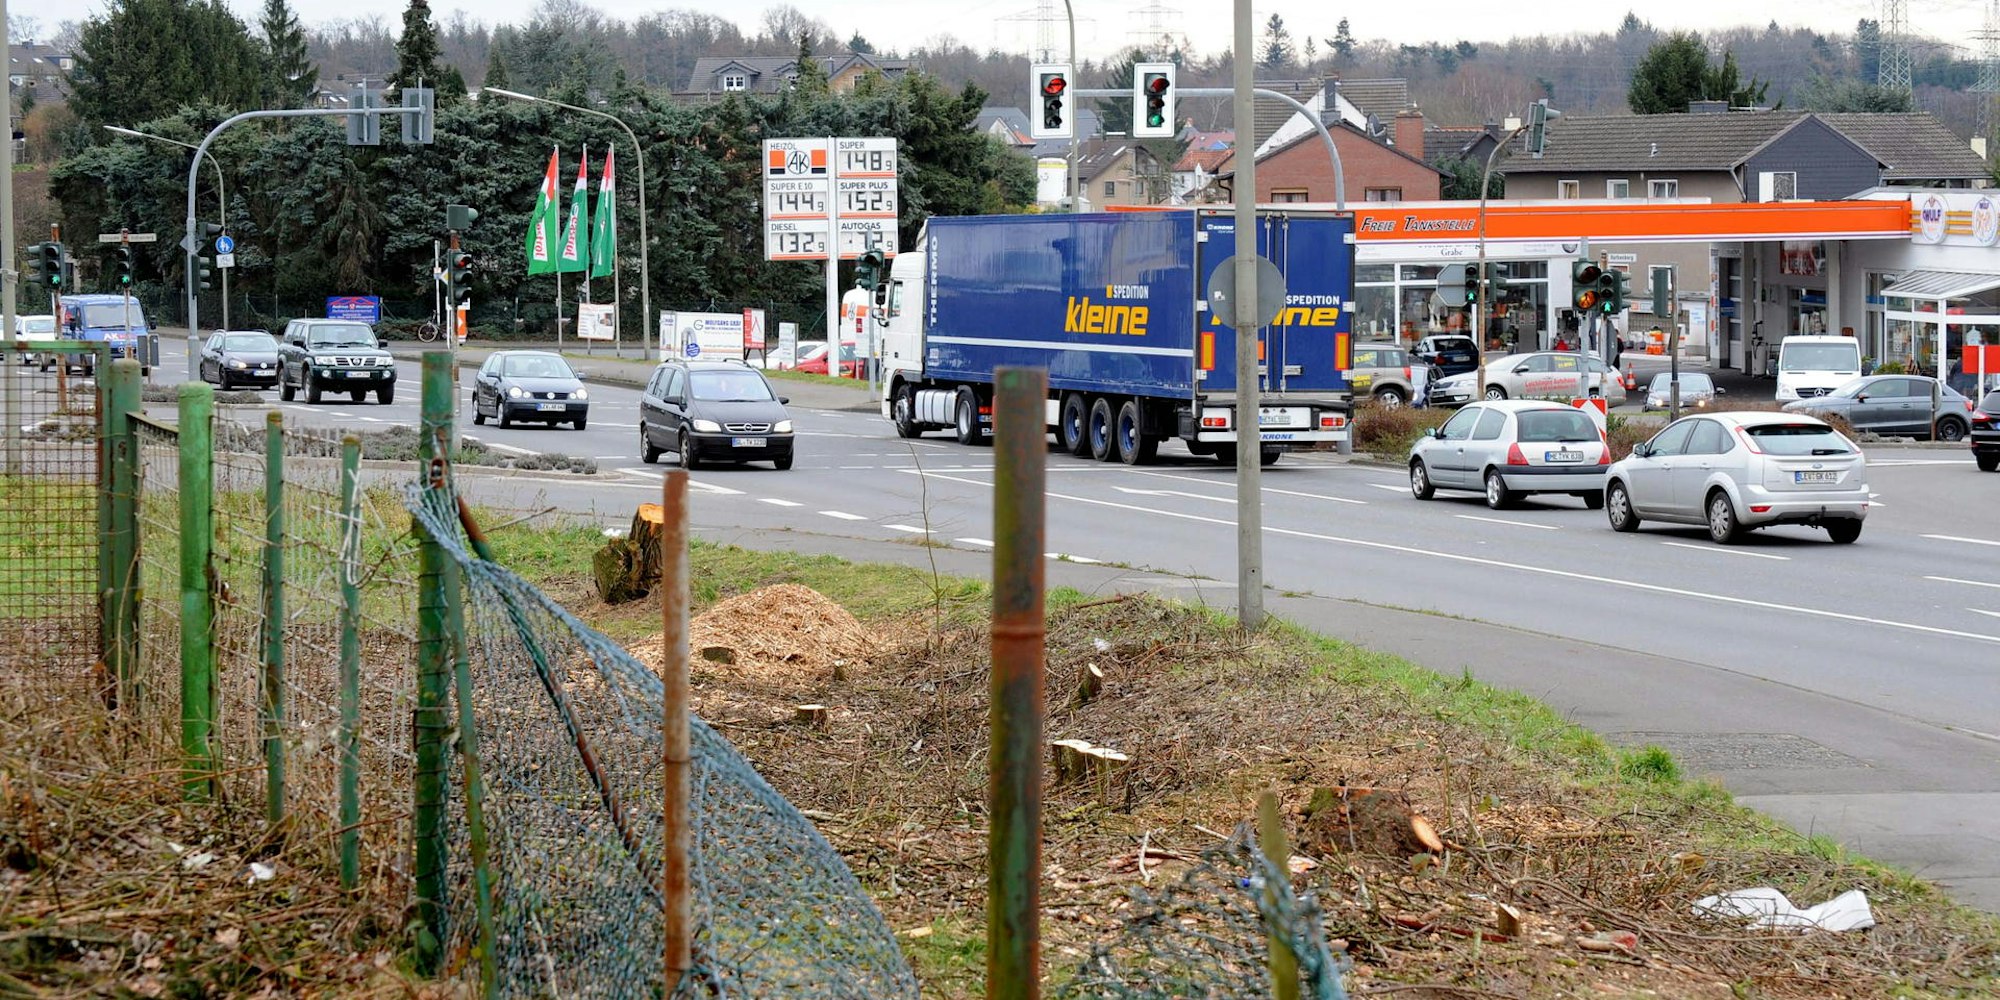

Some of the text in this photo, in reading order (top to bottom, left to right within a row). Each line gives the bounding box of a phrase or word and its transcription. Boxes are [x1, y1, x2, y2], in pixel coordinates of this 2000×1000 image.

[840, 141, 865, 149] SUPER
[771, 182, 795, 191] SUPER
[840, 181, 888, 190] SUPER PLUS
[771, 223, 798, 231] DIESEL
[841, 222, 881, 230] AUTOGAS
[930, 236, 938, 327] THERMO
[1113, 284, 1149, 299] SPEDITION
[1285, 295, 1340, 305] SPEDITION
[1064, 296, 1149, 335] kleine
